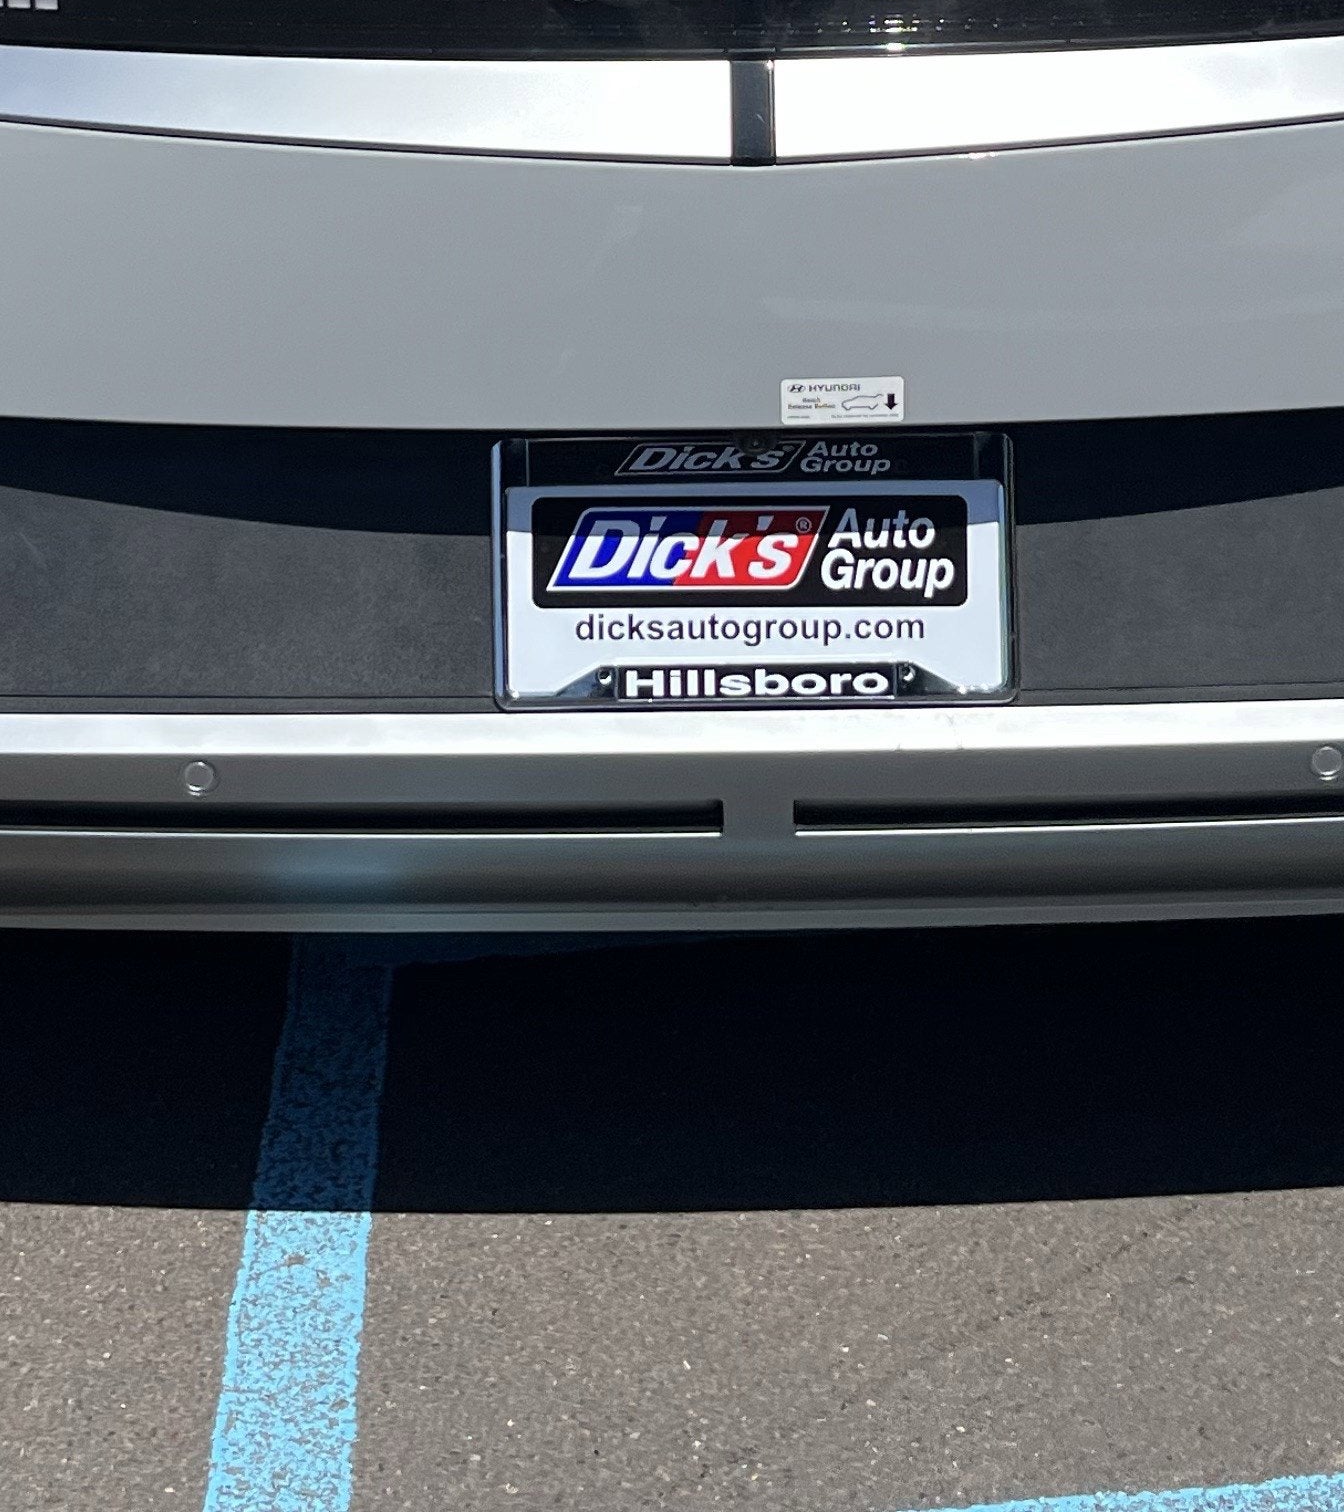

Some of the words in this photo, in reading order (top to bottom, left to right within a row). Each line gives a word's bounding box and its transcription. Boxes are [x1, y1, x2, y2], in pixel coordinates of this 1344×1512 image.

[808, 383, 861, 392] HYUNDAI
[628, 444, 785, 471] Dicks
[807, 440, 879, 457] Auto
[800, 455, 892, 475] Group
[827, 507, 936, 549] Auto
[820, 548, 955, 599] Group
[575, 613, 925, 647] dicksautogroup.com
[624, 668, 890, 698] Hillsboro
